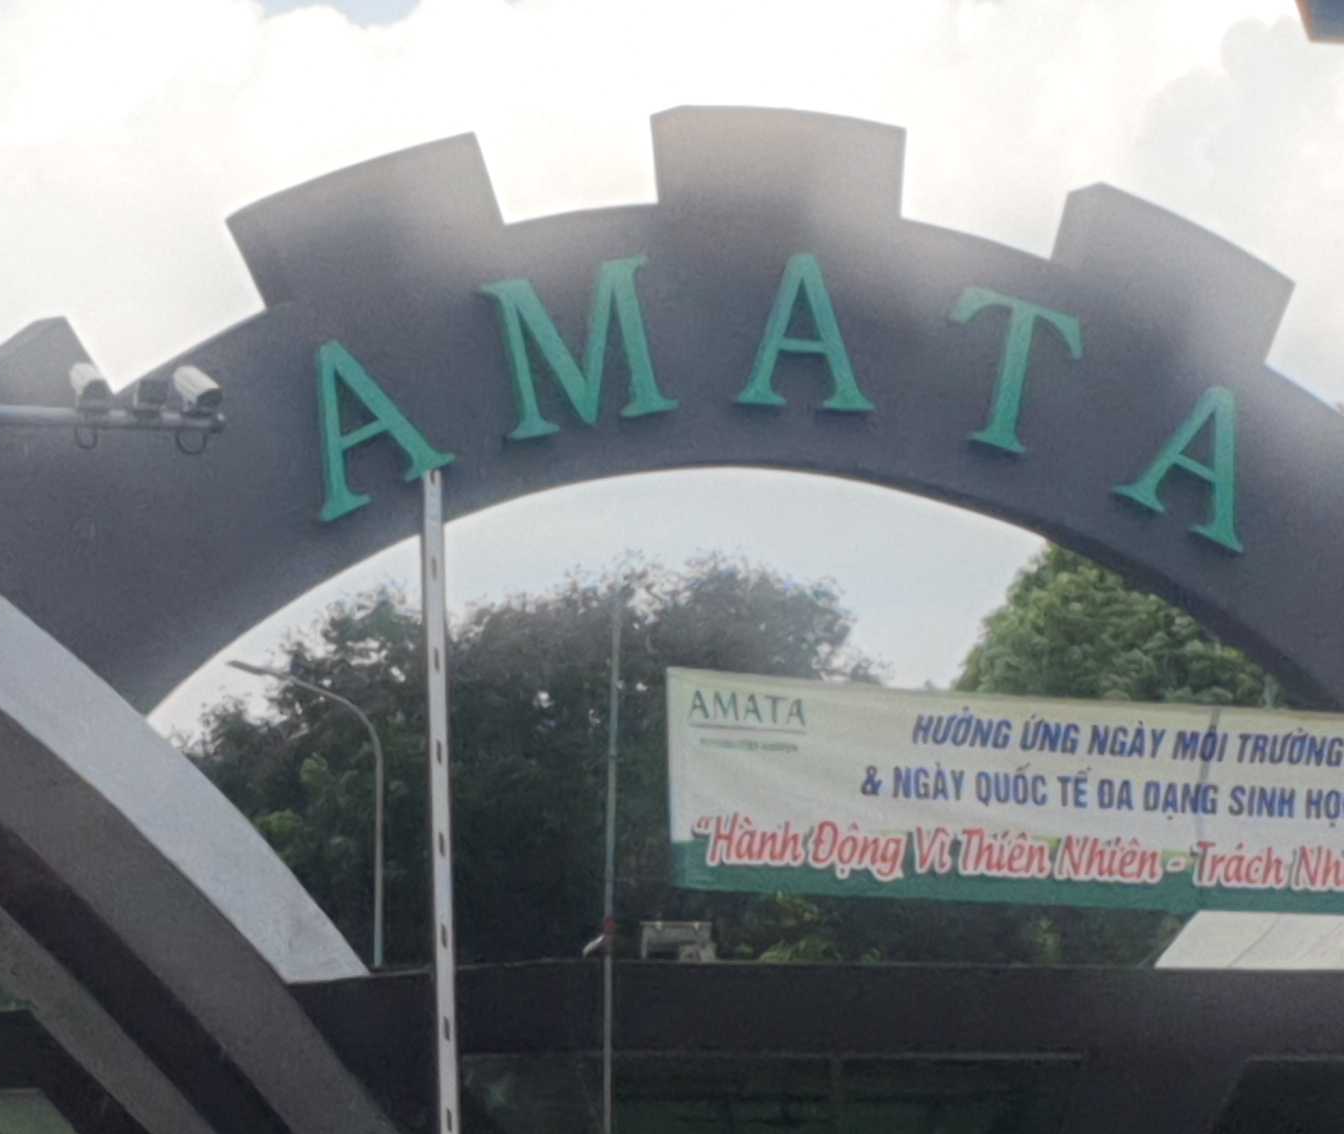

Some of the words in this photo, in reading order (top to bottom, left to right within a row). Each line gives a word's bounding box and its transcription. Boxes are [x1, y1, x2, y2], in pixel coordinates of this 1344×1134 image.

[312, 251, 1244, 556] AMATA
[688, 689, 806, 726] AMATA
[912, 705, 1013, 749] HƯỞNG
[1020, 712, 1080, 755] ỨNG
[1088, 719, 1166, 759] NGÀY
[860, 765, 883, 797] &
[892, 762, 966, 801] NGÀY
[975, 762, 1048, 806] QUỐC
[1056, 766, 1093, 808] TẾ
[1142, 780, 1220, 820] DẠNG
[1228, 784, 1296, 818] SINH
[810, 818, 905, 880] Động
[915, 824, 952, 872] Vì
[960, 826, 1050, 875] Thiên
[1056, 833, 1162, 882] Nhiên
[1193, 840, 1286, 887] Trách
